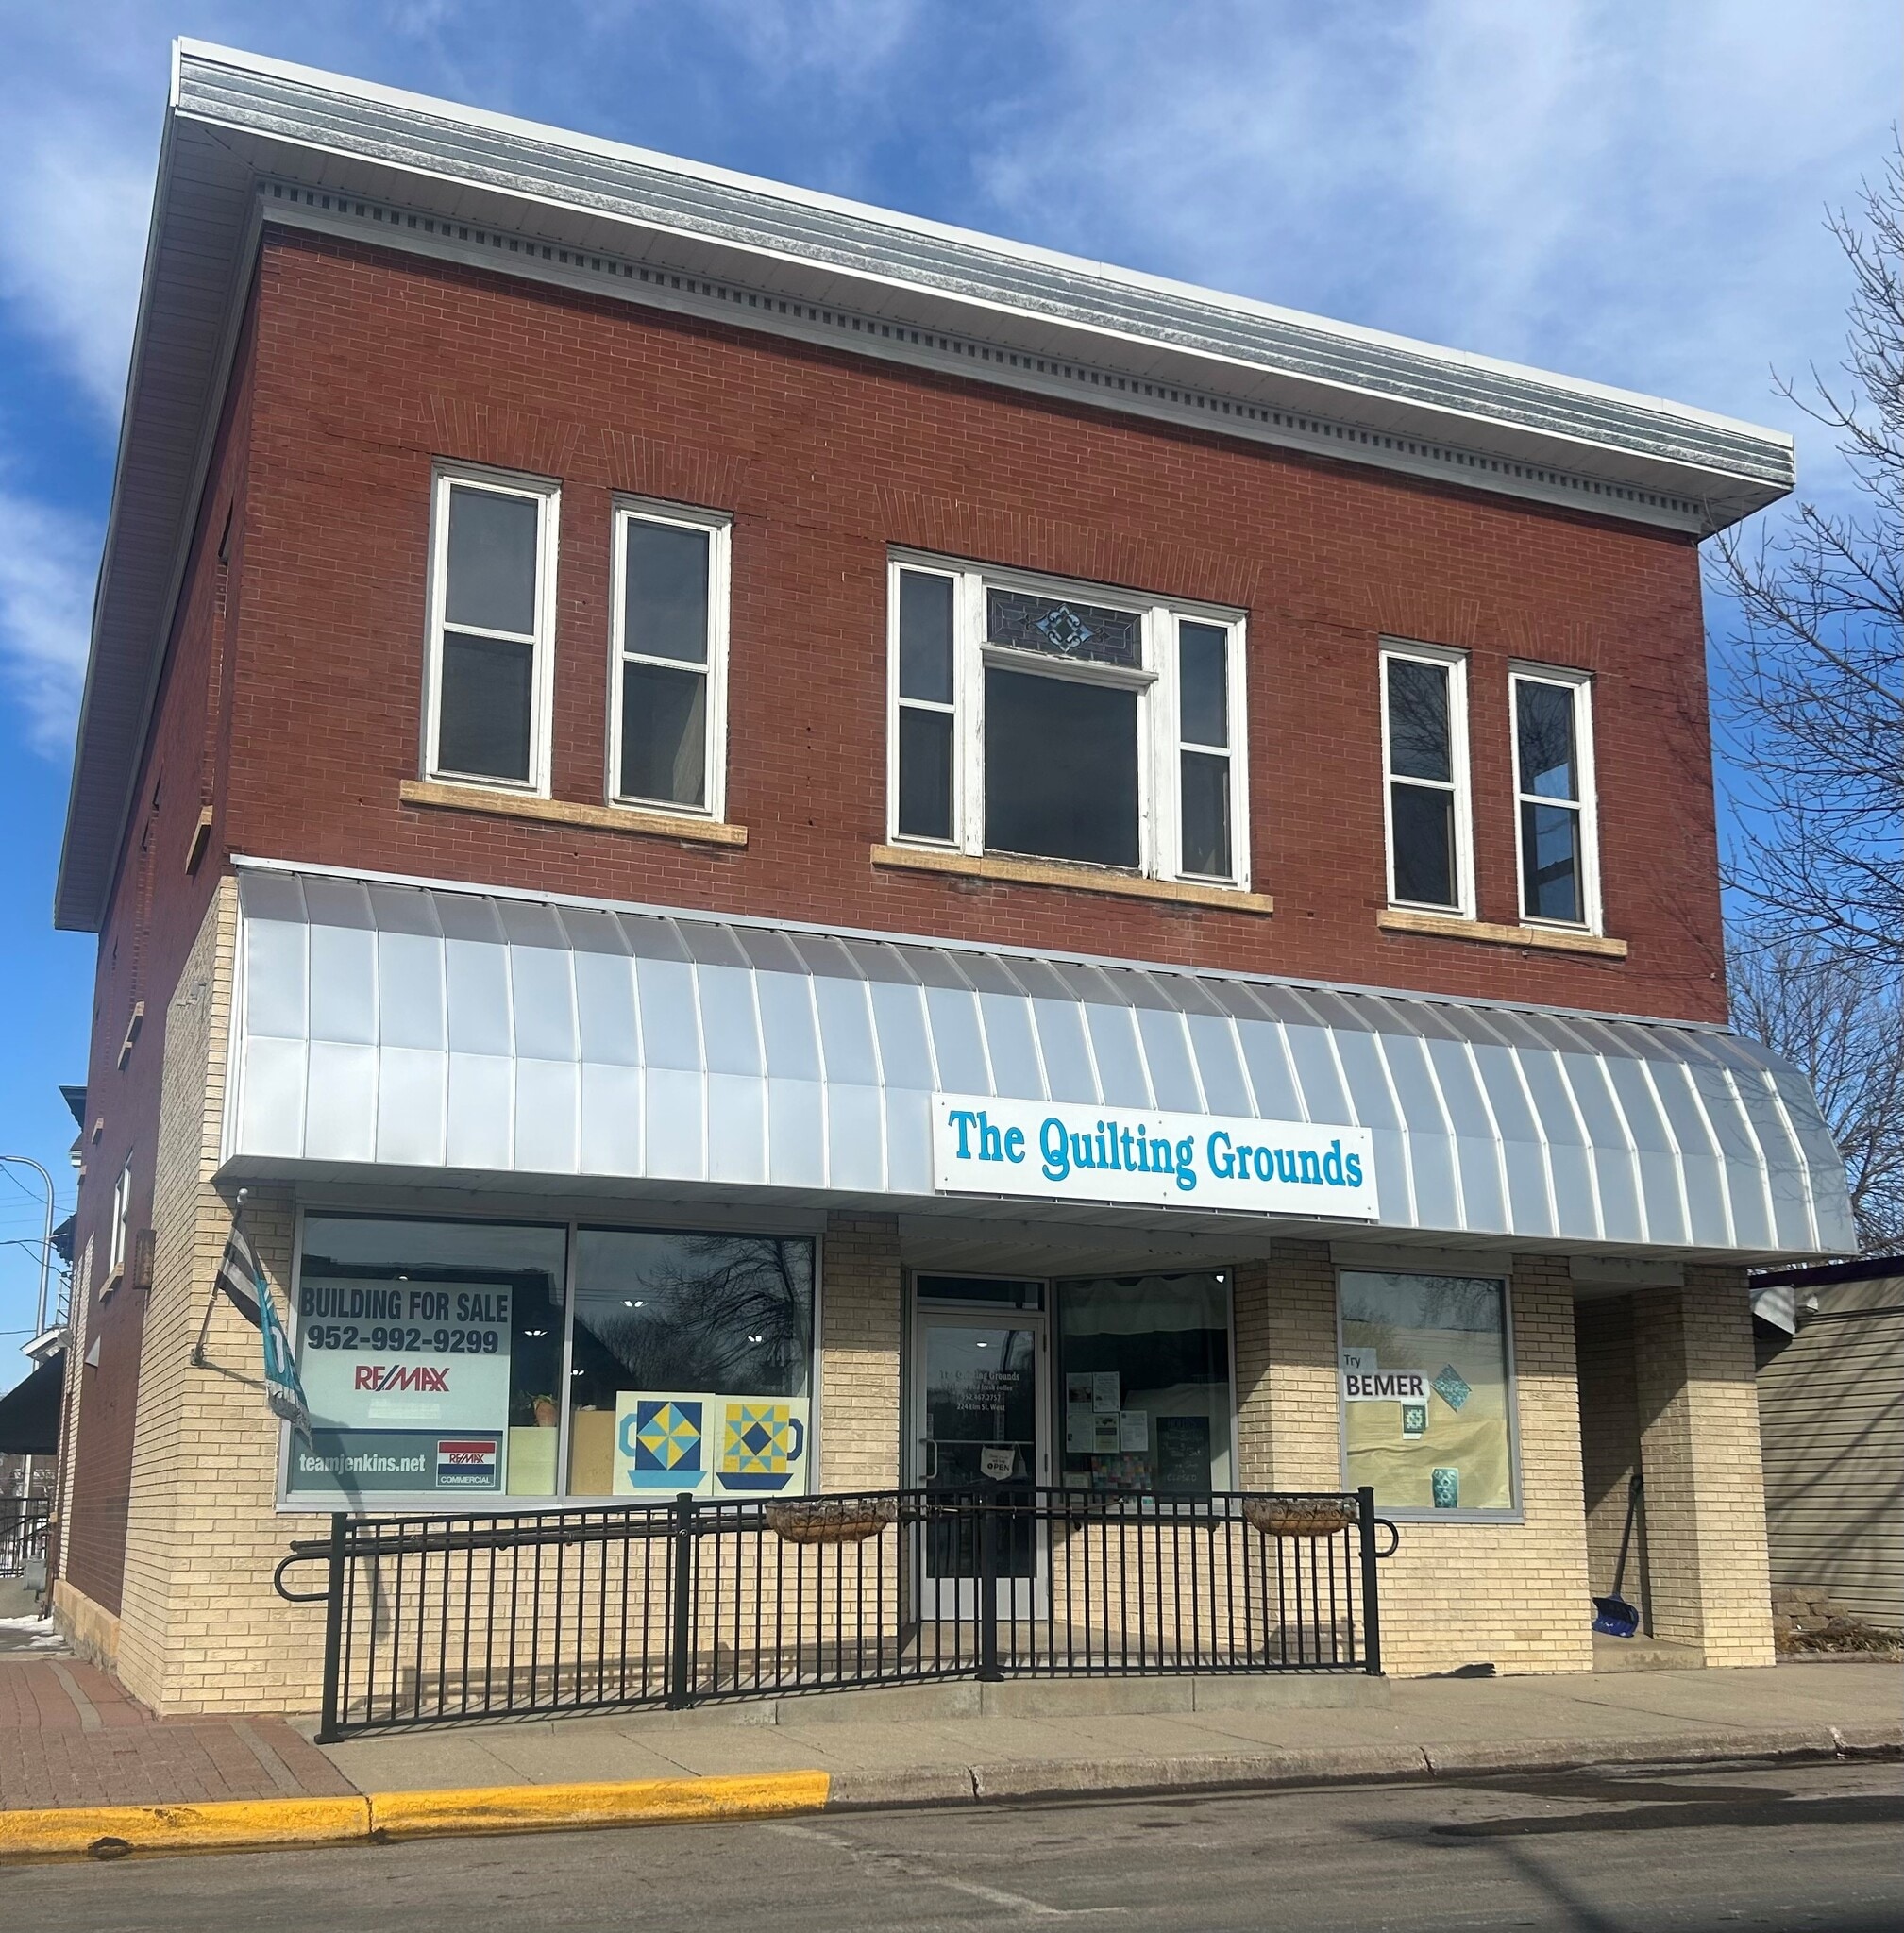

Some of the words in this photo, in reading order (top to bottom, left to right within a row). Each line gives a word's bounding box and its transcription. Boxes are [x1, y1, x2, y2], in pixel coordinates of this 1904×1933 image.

[948, 1110, 1025, 1164] The
[1040, 1117, 1197, 1191] Quilting
[1206, 1131, 1363, 1187] Grounds
[301, 1287, 401, 1319] BUILDING
[409, 1291, 450, 1321] FOR
[457, 1293, 508, 1322] SALE
[308, 1325, 498, 1353] 952-992-9299
[1343, 1354, 1361, 1368] Try
[354, 1365, 450, 1392] RE/MAX
[988, 1371, 1020, 1381] Grounds
[1346, 1374, 1424, 1396] BEMER
[299, 1454, 426, 1474] teamjenkins.net
[449, 1453, 485, 1464] RE/MAX
